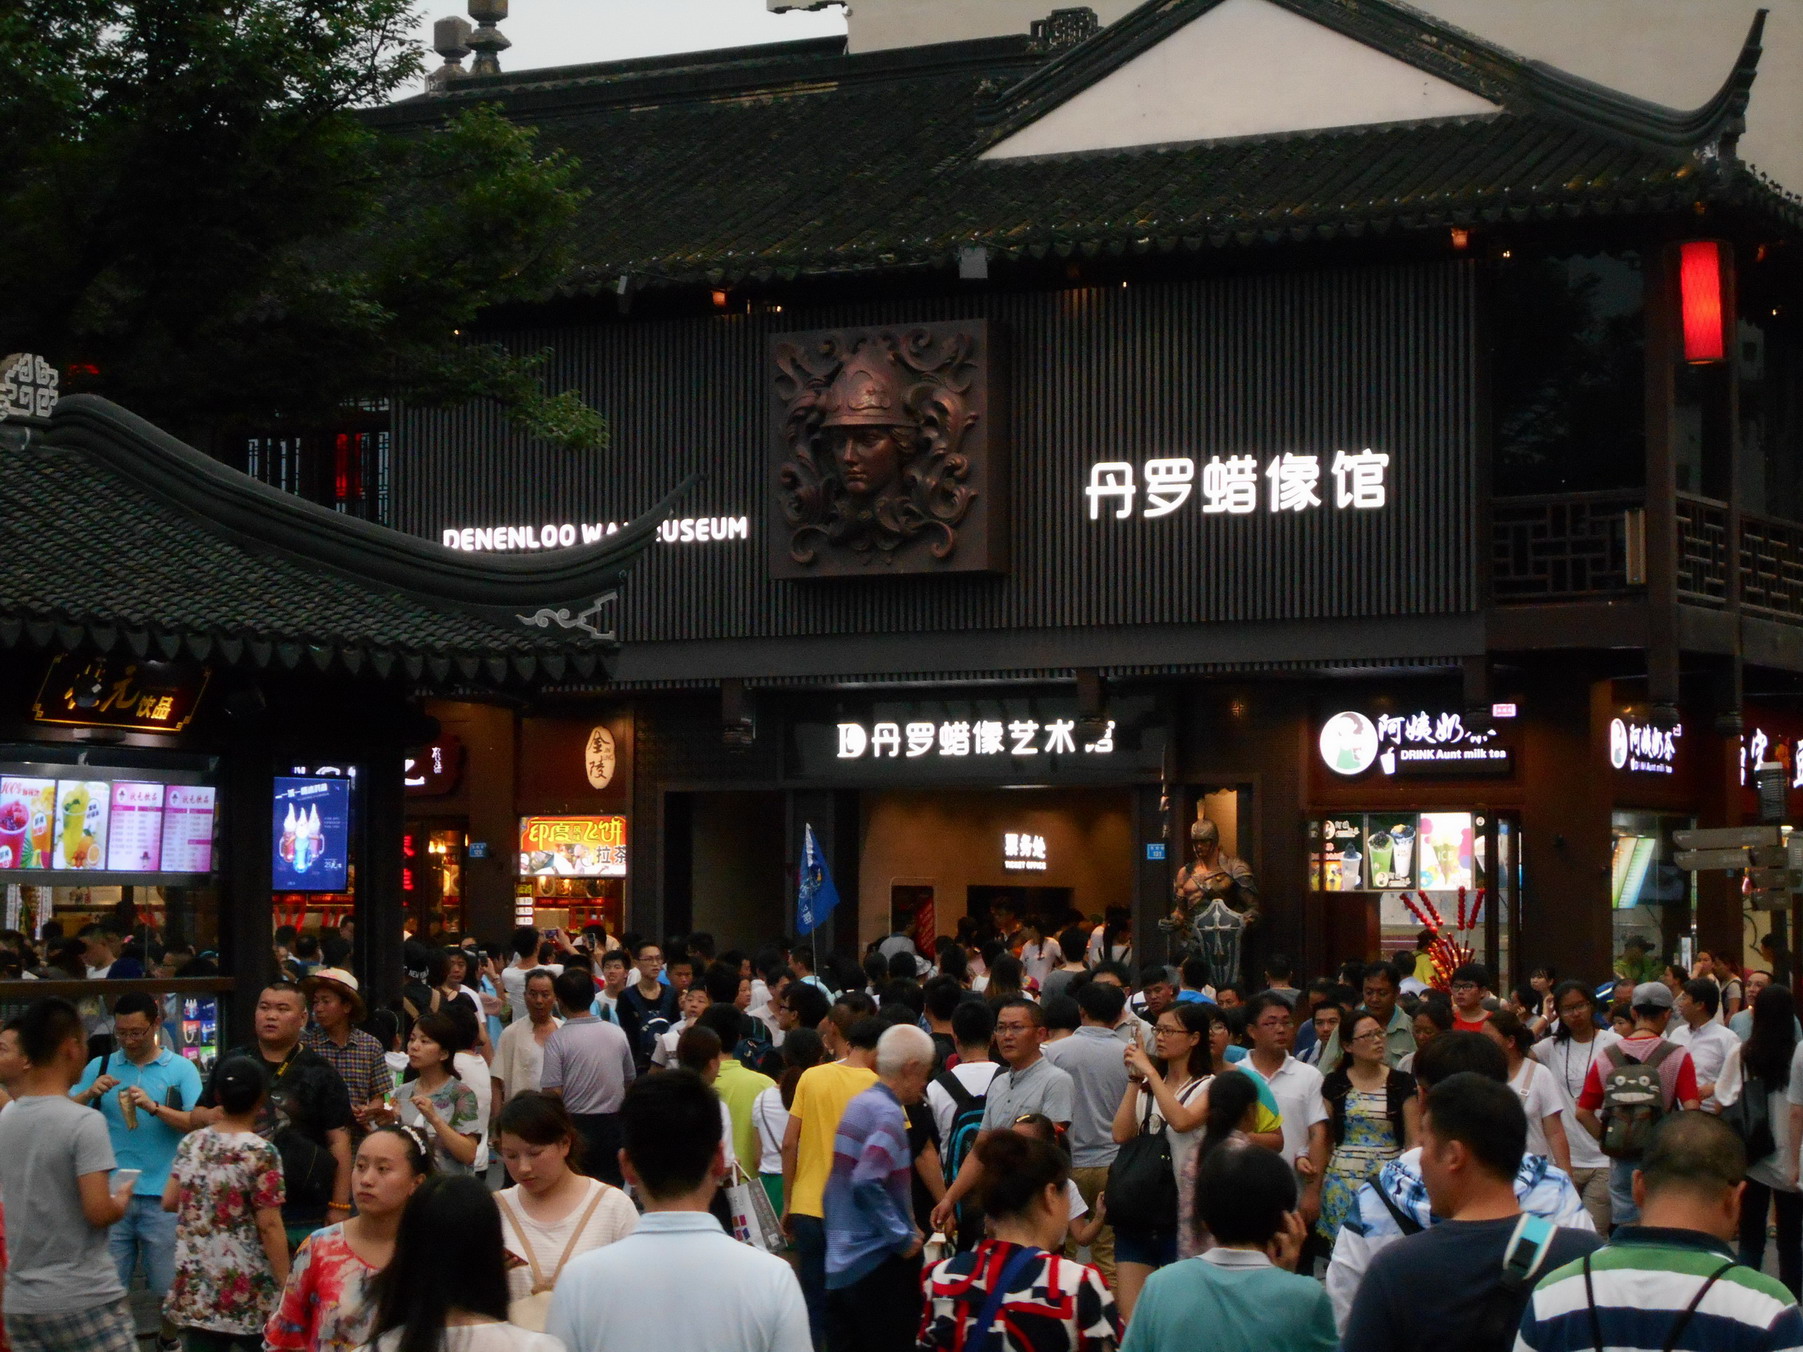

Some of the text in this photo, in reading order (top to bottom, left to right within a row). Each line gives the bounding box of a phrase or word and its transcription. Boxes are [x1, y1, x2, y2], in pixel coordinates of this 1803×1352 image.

[1085, 447, 1390, 520] 丹罗蜡像馆
[443, 523, 576, 551] DENENLOO
[1400, 748, 1507, 761] DRINK Aunt milk tea
[596, 845, 627, 865] 拉茶
